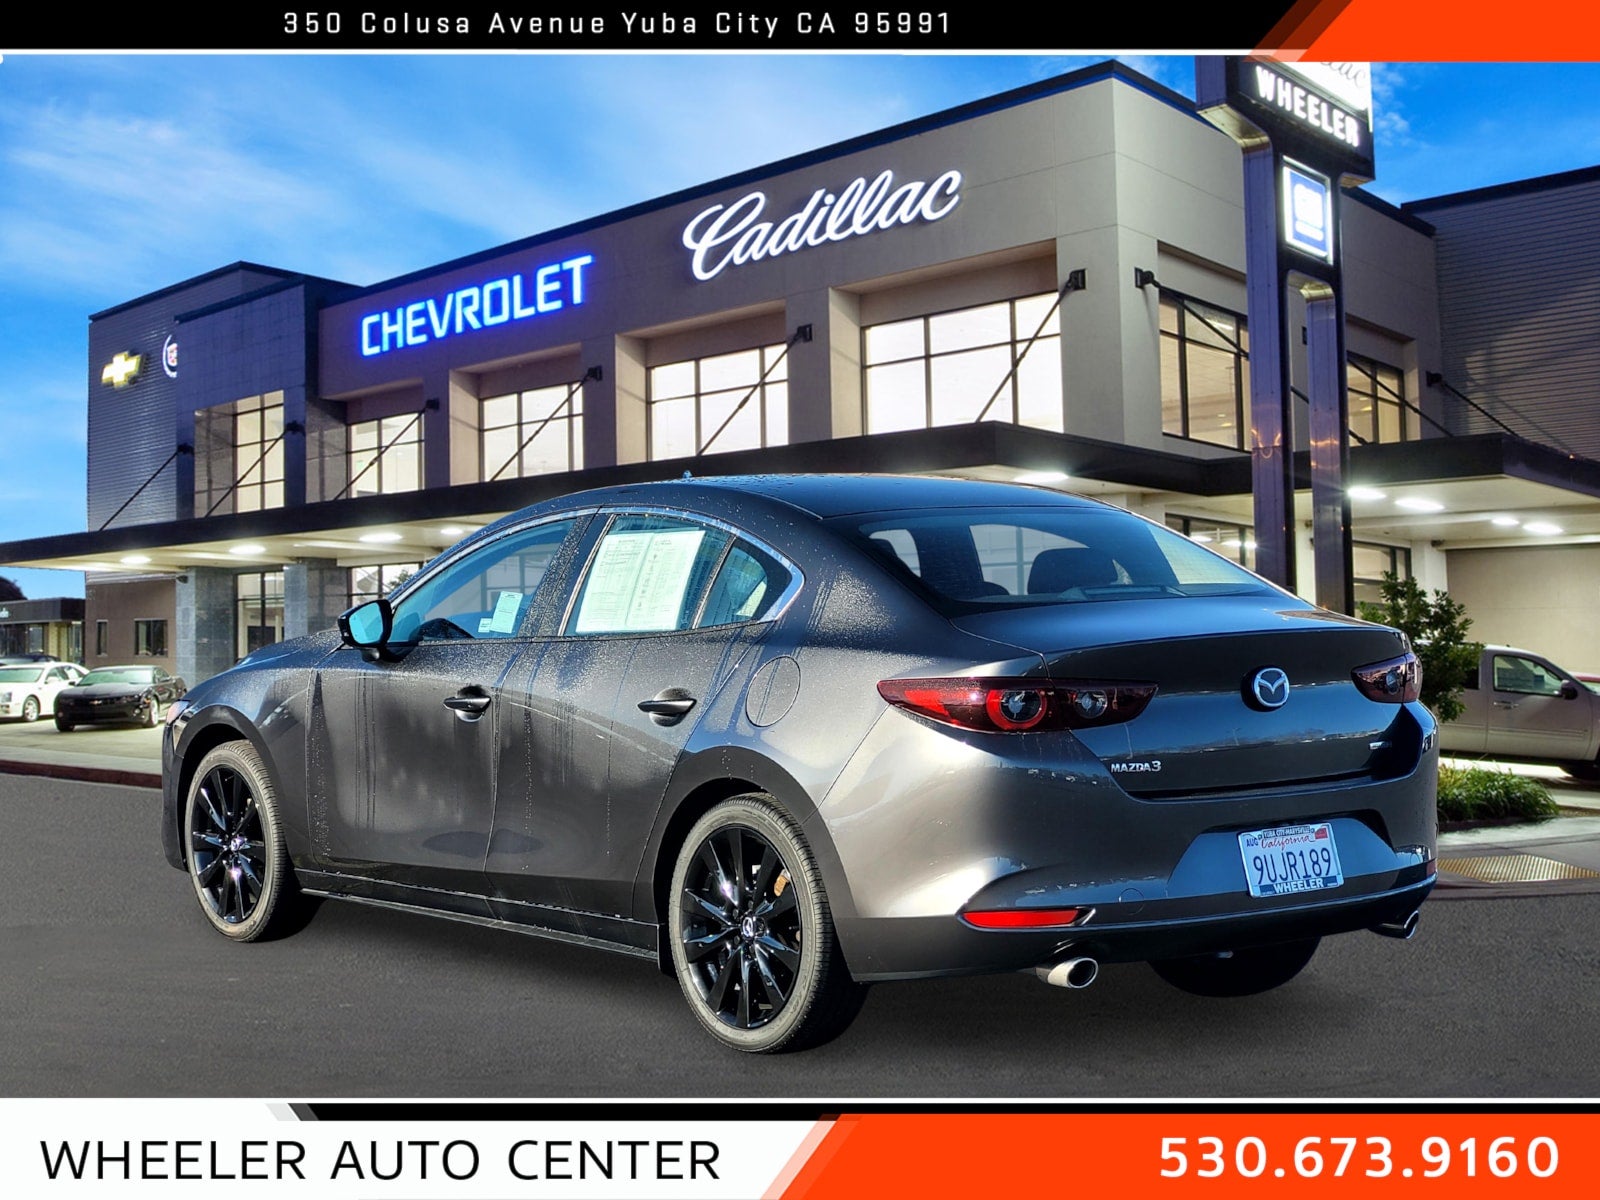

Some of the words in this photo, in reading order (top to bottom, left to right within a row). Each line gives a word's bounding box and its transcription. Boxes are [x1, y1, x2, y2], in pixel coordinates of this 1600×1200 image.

[1255, 66, 1360, 147] WHEELER
[683, 169, 963, 281] Cadillac
[361, 255, 593, 357] CHEVROLET
[1110, 760, 1162, 773] MAZDA3
[1246, 837, 1259, 847] AUG
[1261, 834, 1317, 850] California
[1253, 847, 1331, 884] 9UJR189
[1274, 878, 1323, 893] WHEELER
